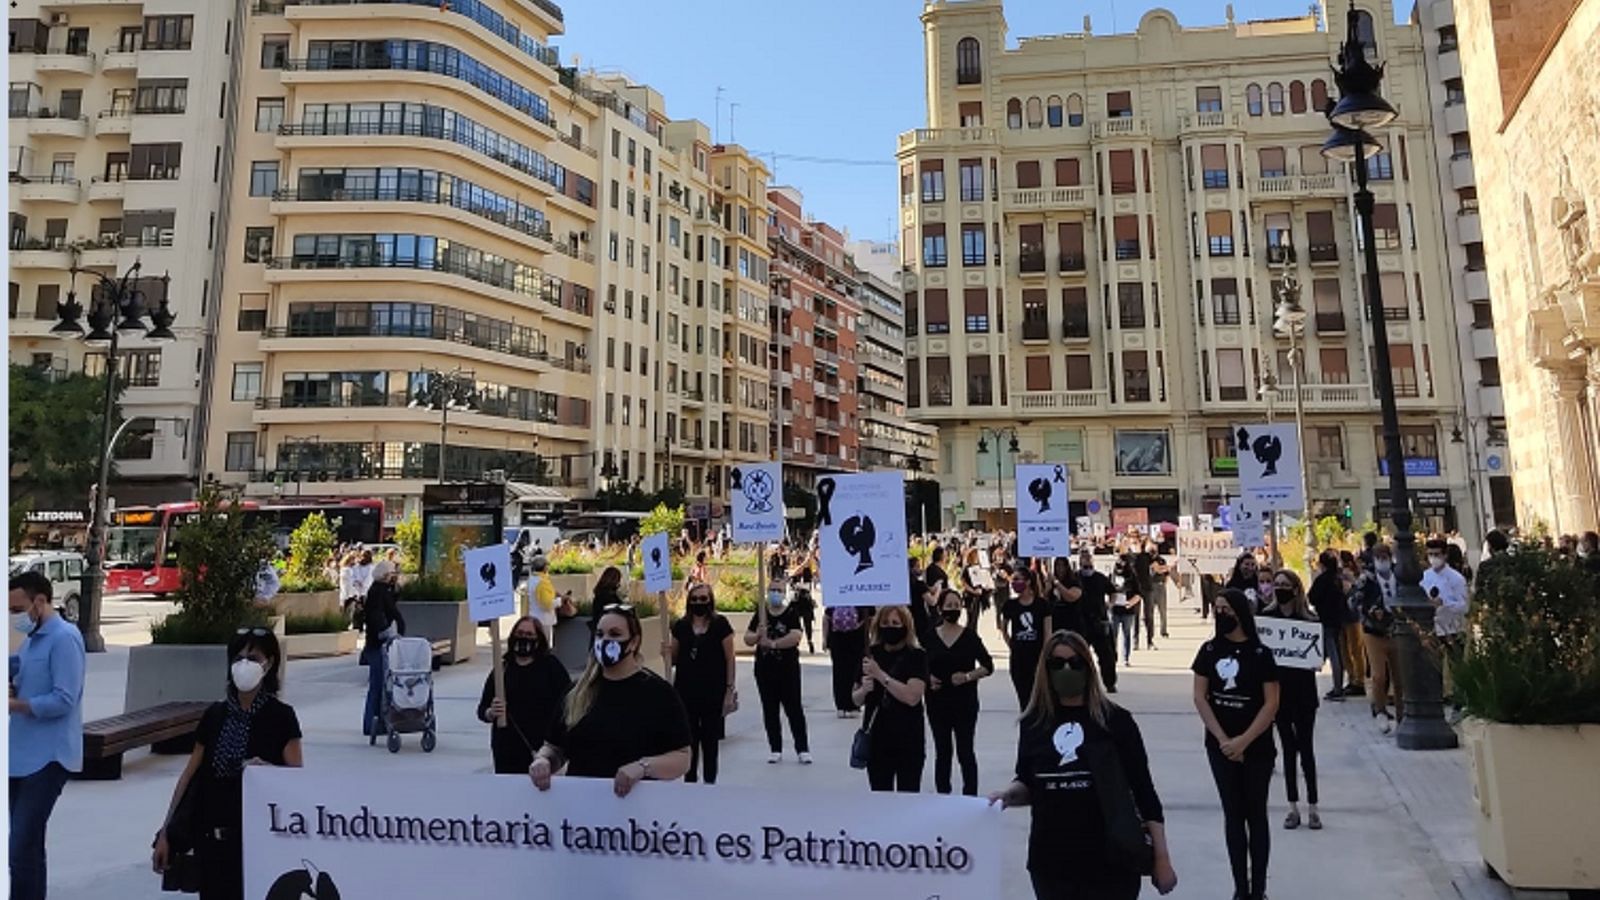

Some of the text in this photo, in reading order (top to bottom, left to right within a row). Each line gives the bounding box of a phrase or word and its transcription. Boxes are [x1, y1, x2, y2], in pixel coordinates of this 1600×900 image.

[267, 803, 969, 871] La Indumentaria también es Patrimonio
